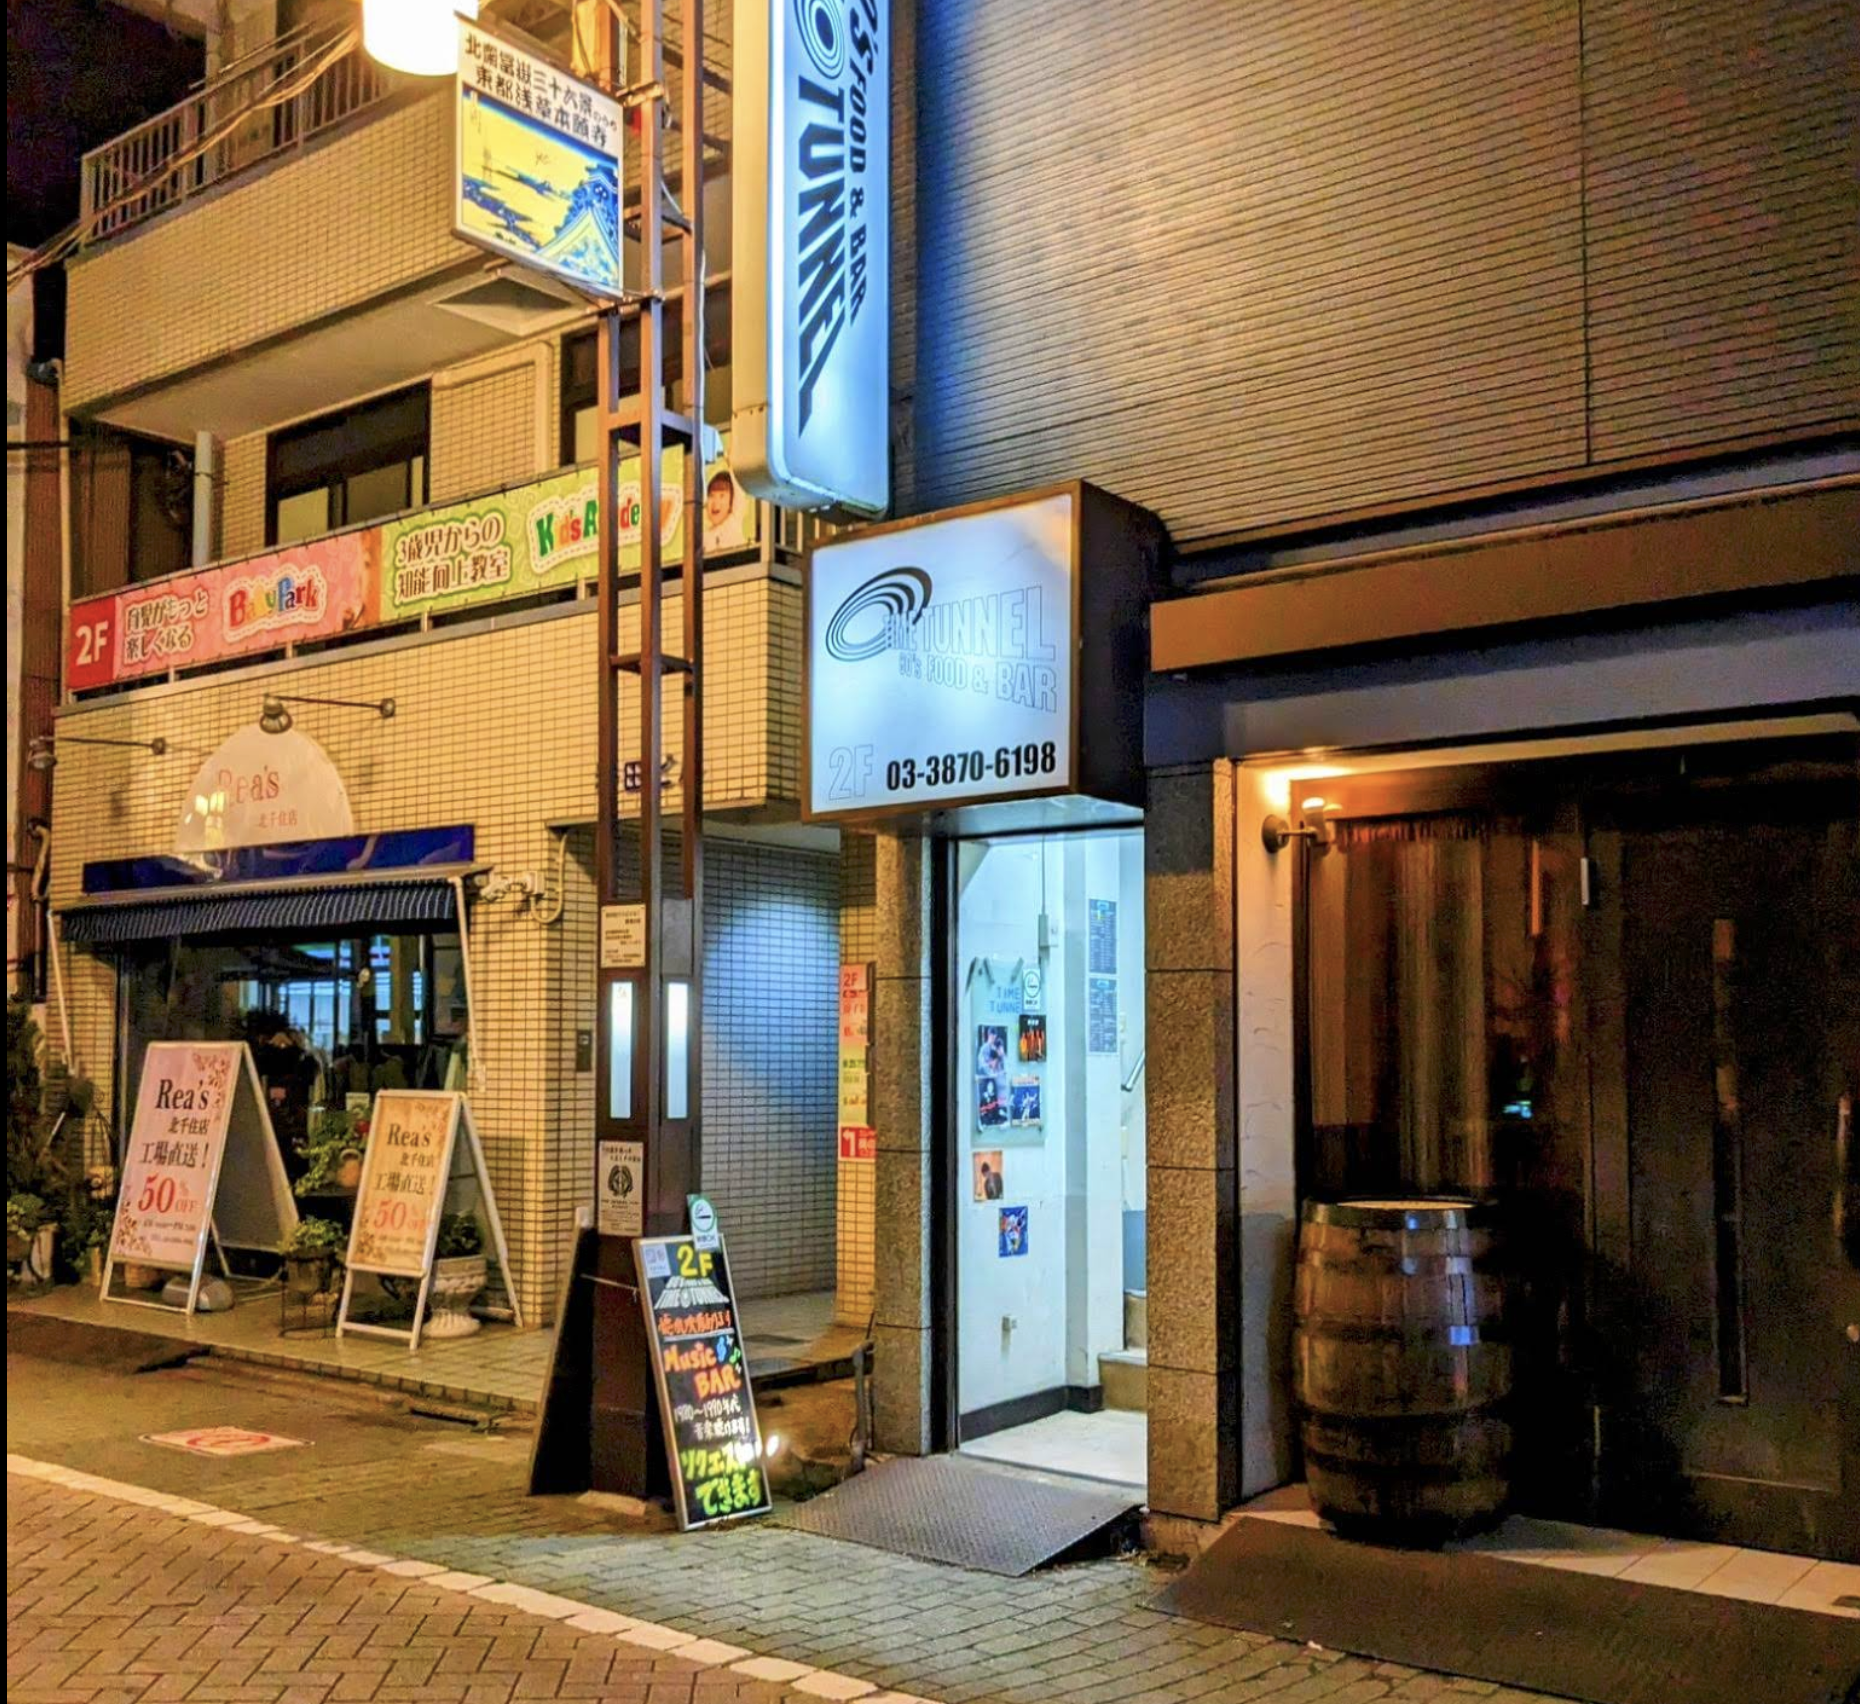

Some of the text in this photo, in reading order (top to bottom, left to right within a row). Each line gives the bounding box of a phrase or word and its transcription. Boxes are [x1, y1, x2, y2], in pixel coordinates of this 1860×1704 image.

[849, 62, 868, 174] FOOD
[850, 188, 865, 219] &
[797, 75, 846, 439] TUNNEL
[849, 224, 867, 327] BAR
[398, 549, 508, 598] 知能向上教室
[75, 621, 108, 666] 2F
[920, 585, 1056, 662] TUNNEL
[926, 654, 968, 690] FOOD
[972, 665, 989, 694] &
[995, 664, 1057, 713] BAR
[828, 741, 1057, 801] 2F 03-3870-6198
[155, 1078, 210, 1111] Rea's
[168, 1117, 210, 1135] 北千住店
[387, 1123, 433, 1147] Rea's
[677, 1244, 714, 1278] 2F
[663, 1341, 717, 1372] Music
[694, 1364, 742, 1399] BAR
[695, 1469, 762, 1516] できます
